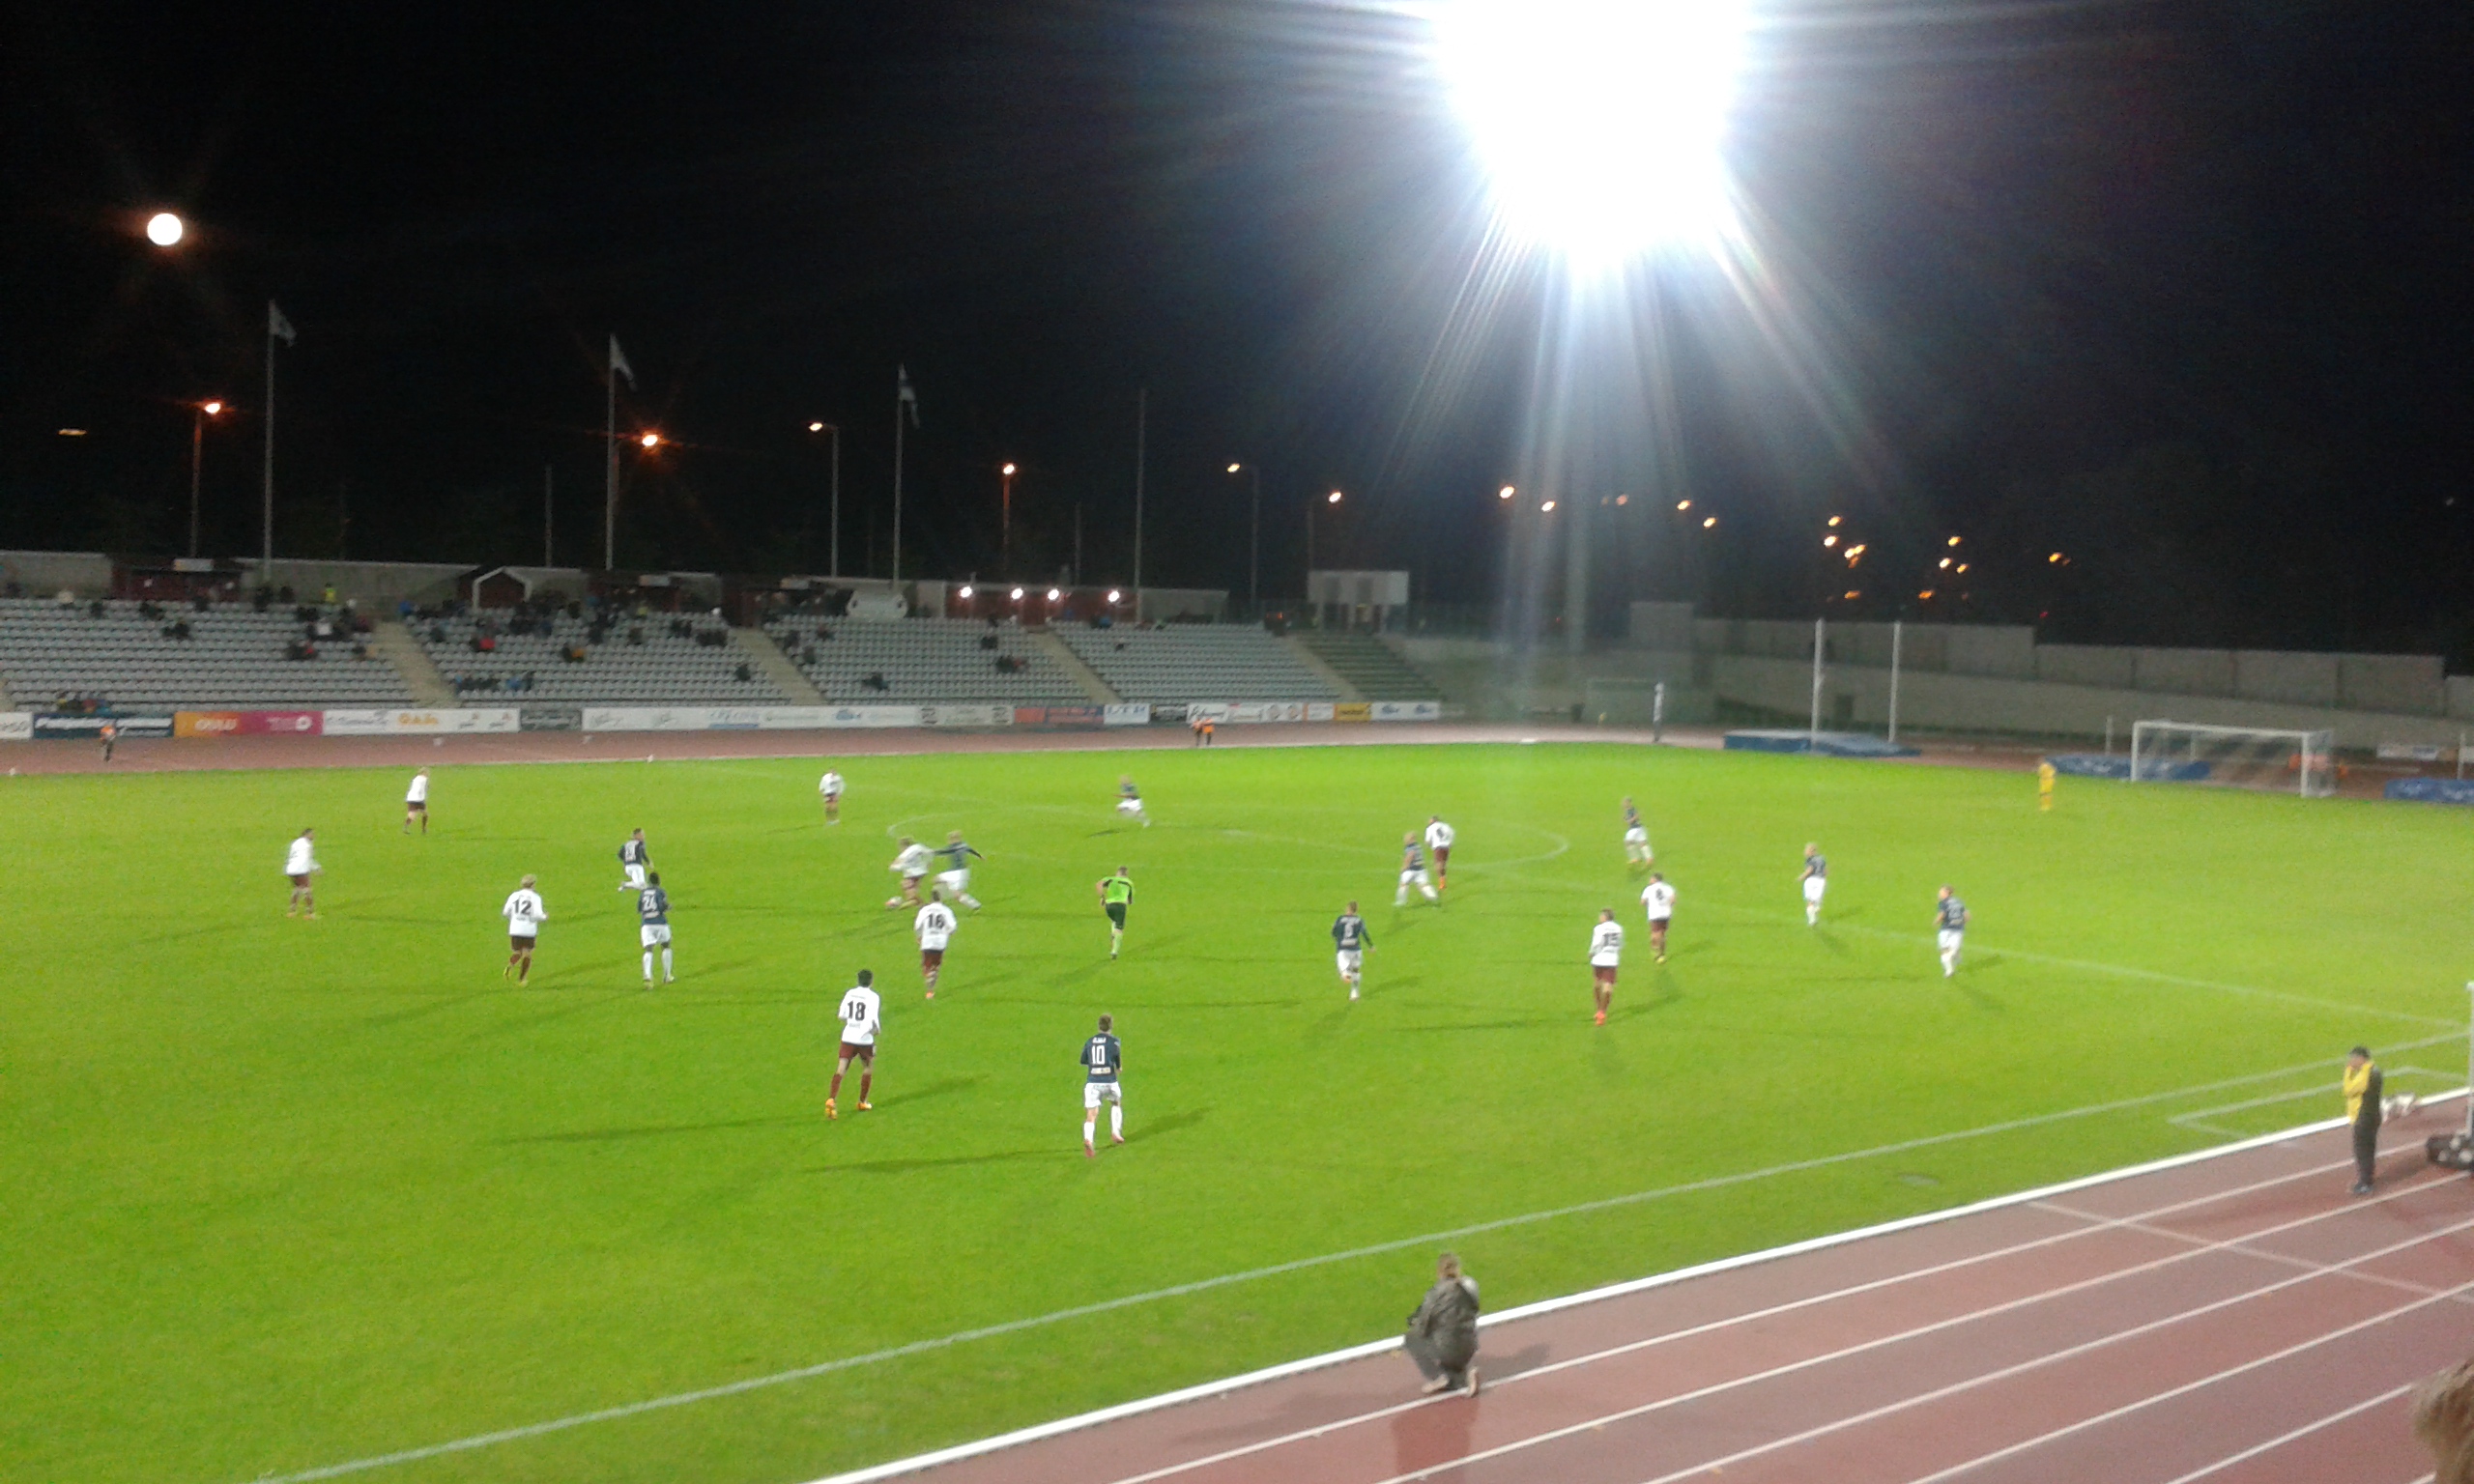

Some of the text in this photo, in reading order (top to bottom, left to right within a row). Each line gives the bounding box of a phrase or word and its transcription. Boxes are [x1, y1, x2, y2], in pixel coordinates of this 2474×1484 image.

[512, 899, 532, 915] 12
[928, 913, 945, 928] 16
[848, 1000, 866, 1021] 18
[1091, 1044, 1106, 1065] 10
